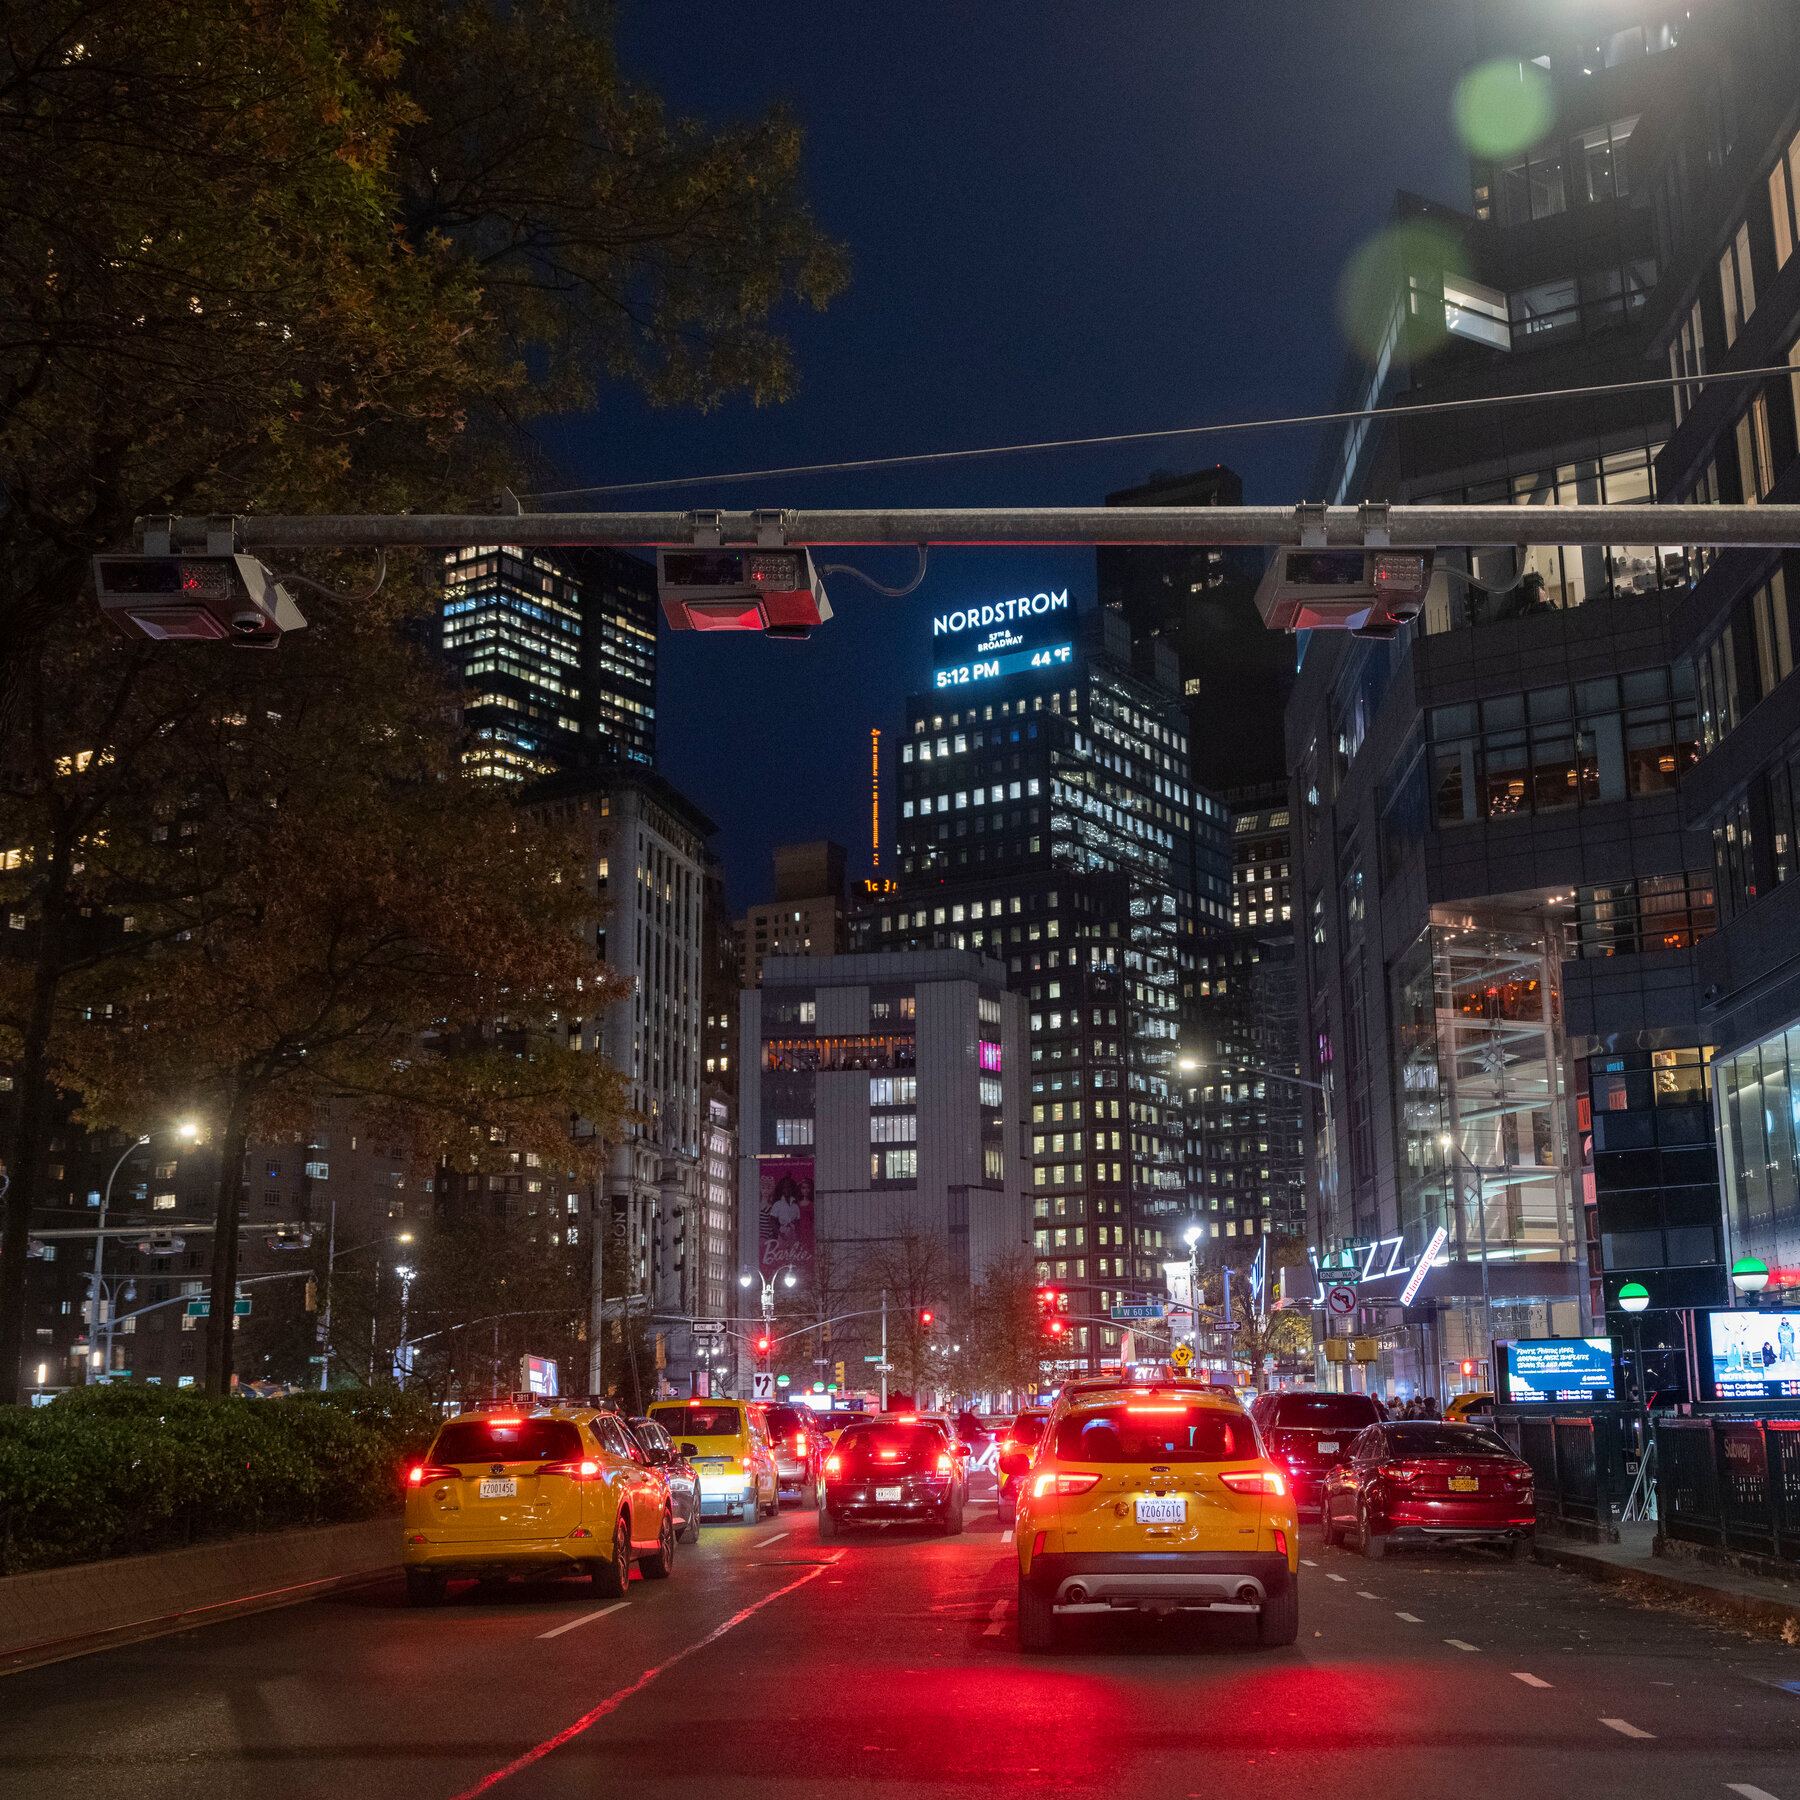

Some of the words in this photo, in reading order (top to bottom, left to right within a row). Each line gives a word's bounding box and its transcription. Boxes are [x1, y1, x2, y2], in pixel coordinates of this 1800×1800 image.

[933, 588, 1068, 636] NORDSTROM
[988, 631, 1004, 641] 57TH
[1005, 630, 1011, 638] &
[978, 635, 1023, 652] BROADWAY
[937, 667, 969, 687] 5:12
[973, 660, 999, 680] PM
[1031, 651, 1051, 667] 44
[1353, 1239, 1361, 1247] 60
[762, 1239, 812, 1264] Barbie
[1404, 1292, 1412, 1303] at
[1409, 1261, 1429, 1291] lincoln
[1427, 1231, 1444, 1260] center
[1133, 1308, 1143, 1316] 60
[1145, 1307, 1152, 1315] St
[1134, 1367, 1160, 1380] 2Y74
[1723, 1438, 1750, 1463] Subway
[483, 1483, 514, 1494] Y200145C
[1140, 1505, 1181, 1518] Y206761C
